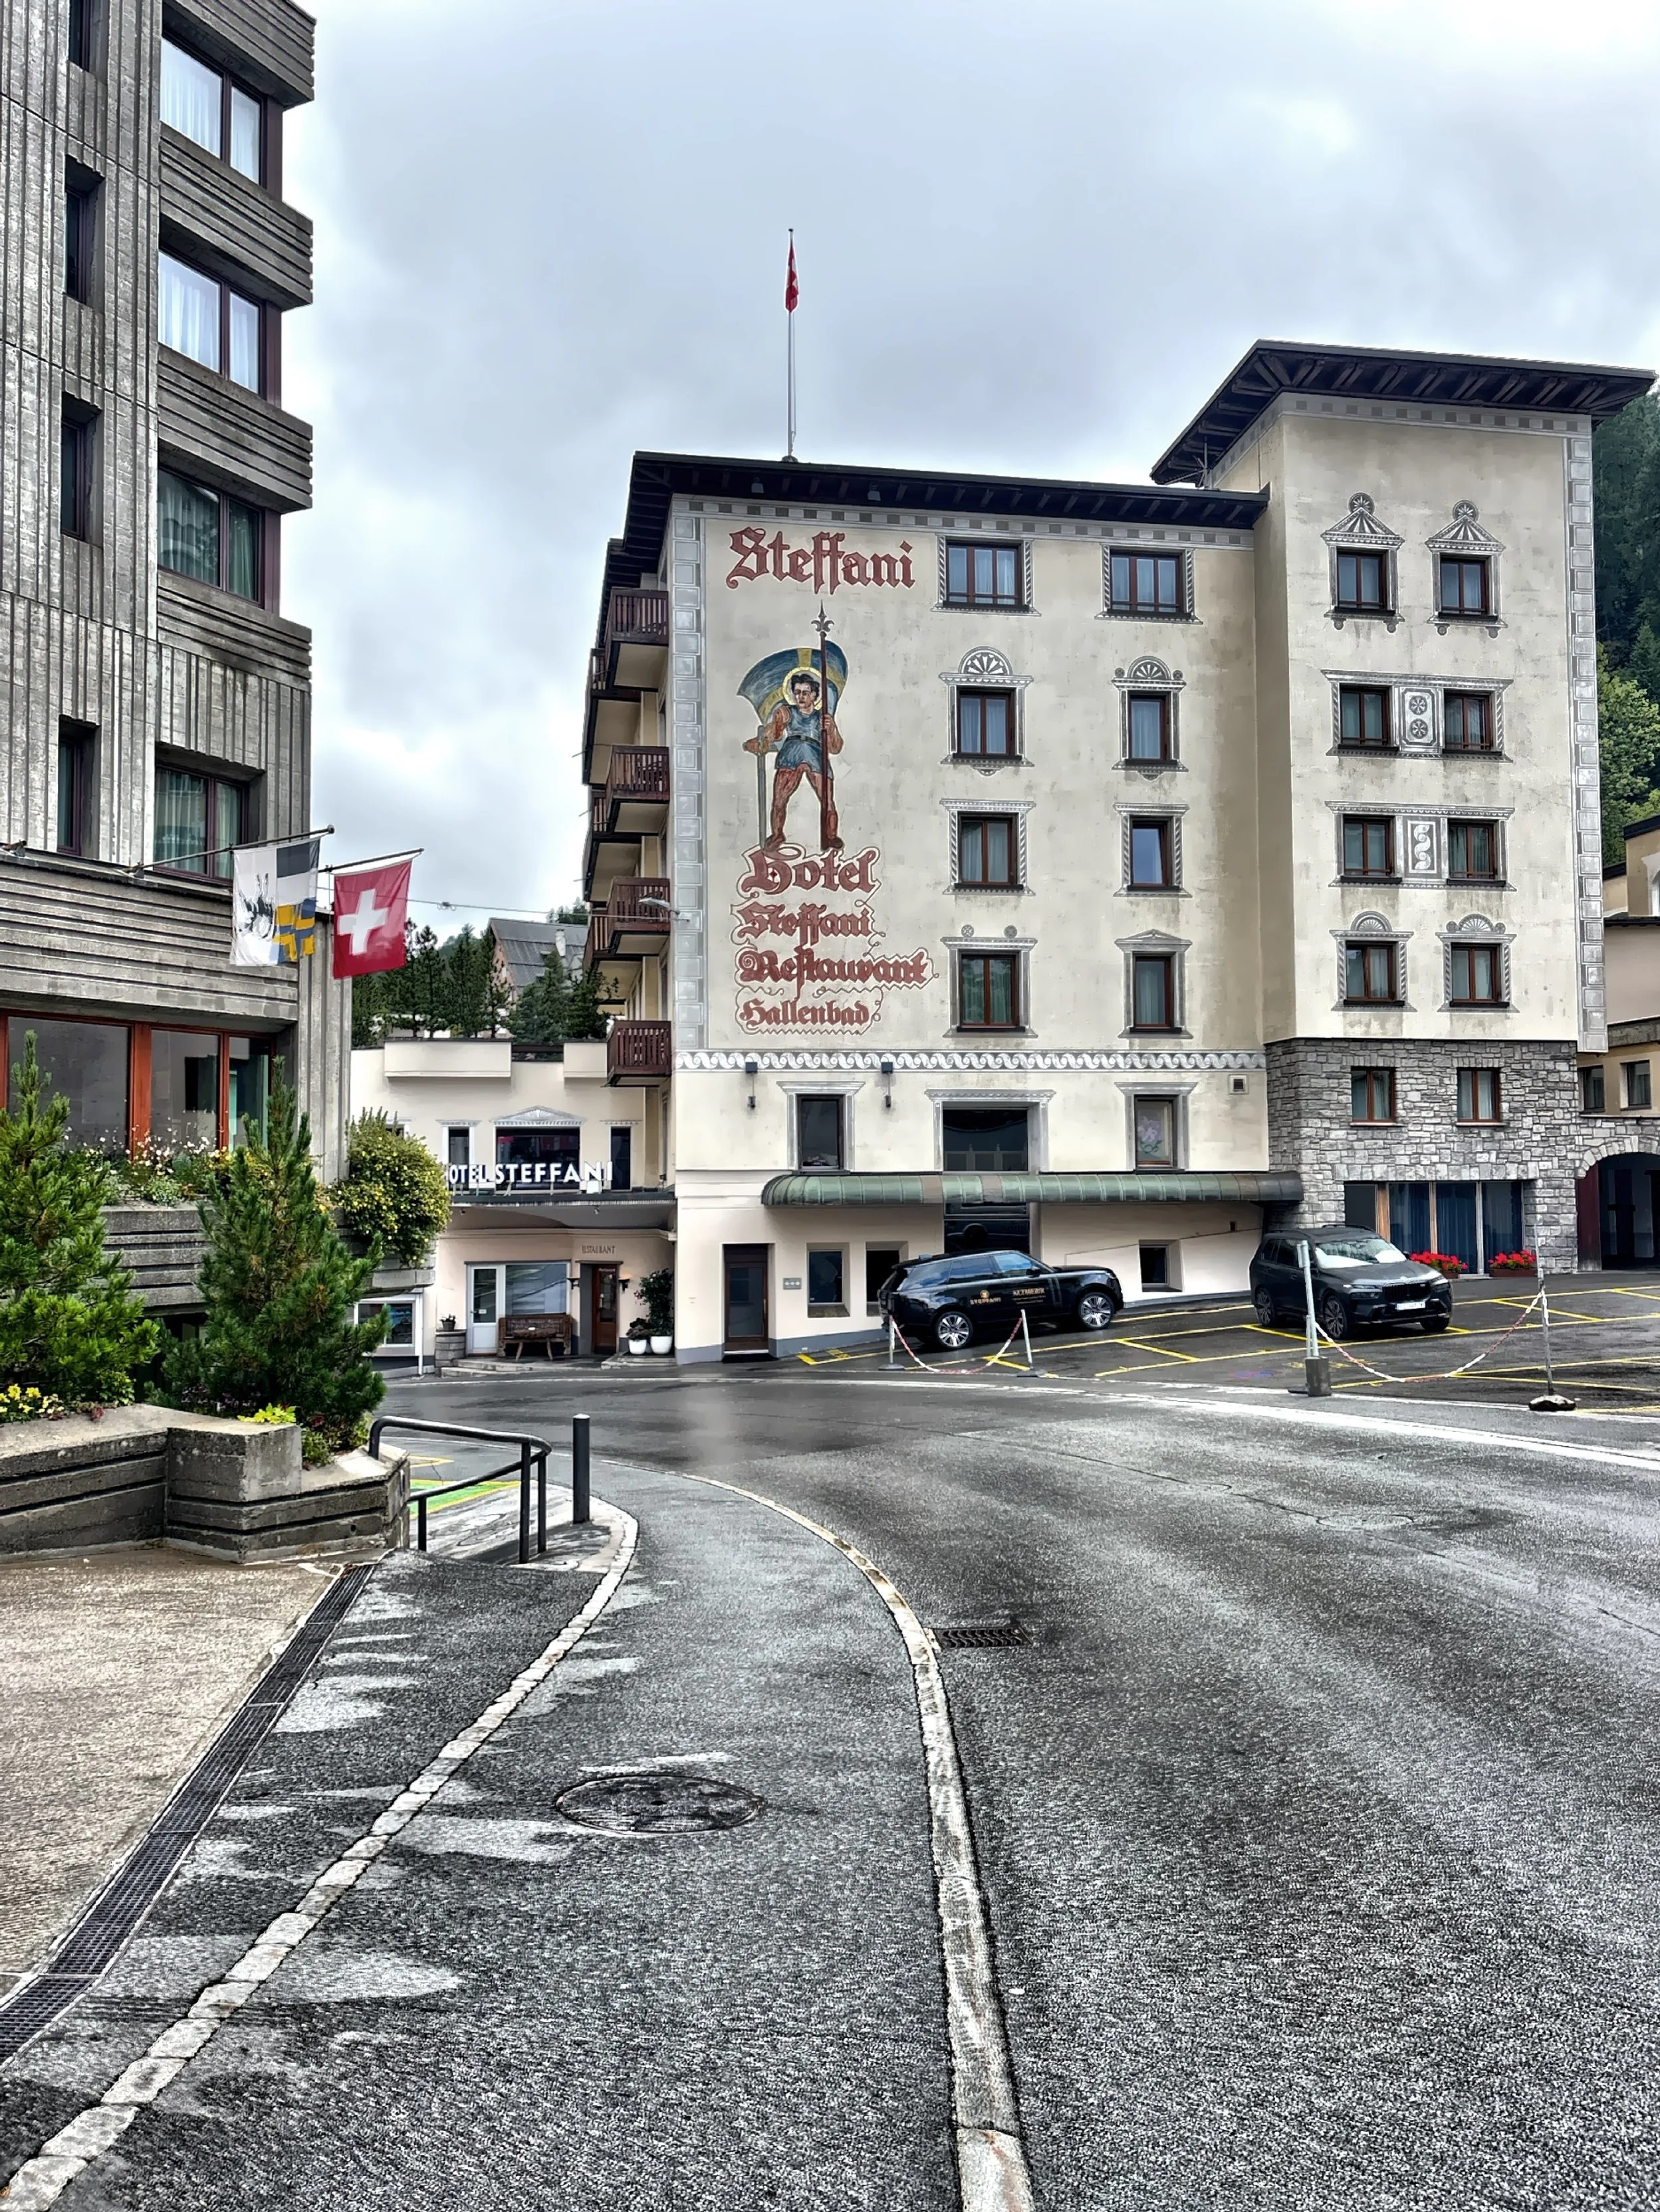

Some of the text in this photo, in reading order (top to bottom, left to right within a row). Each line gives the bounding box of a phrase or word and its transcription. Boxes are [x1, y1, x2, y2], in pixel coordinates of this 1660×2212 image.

[726, 527, 915, 595] Steffani
[741, 848, 877, 896] Hotel
[737, 902, 872, 946] Steffani
[738, 946, 927, 999] Restaurant
[739, 999, 870, 1029] Hallenbad
[495, 1161, 613, 1184] STEFFANI
